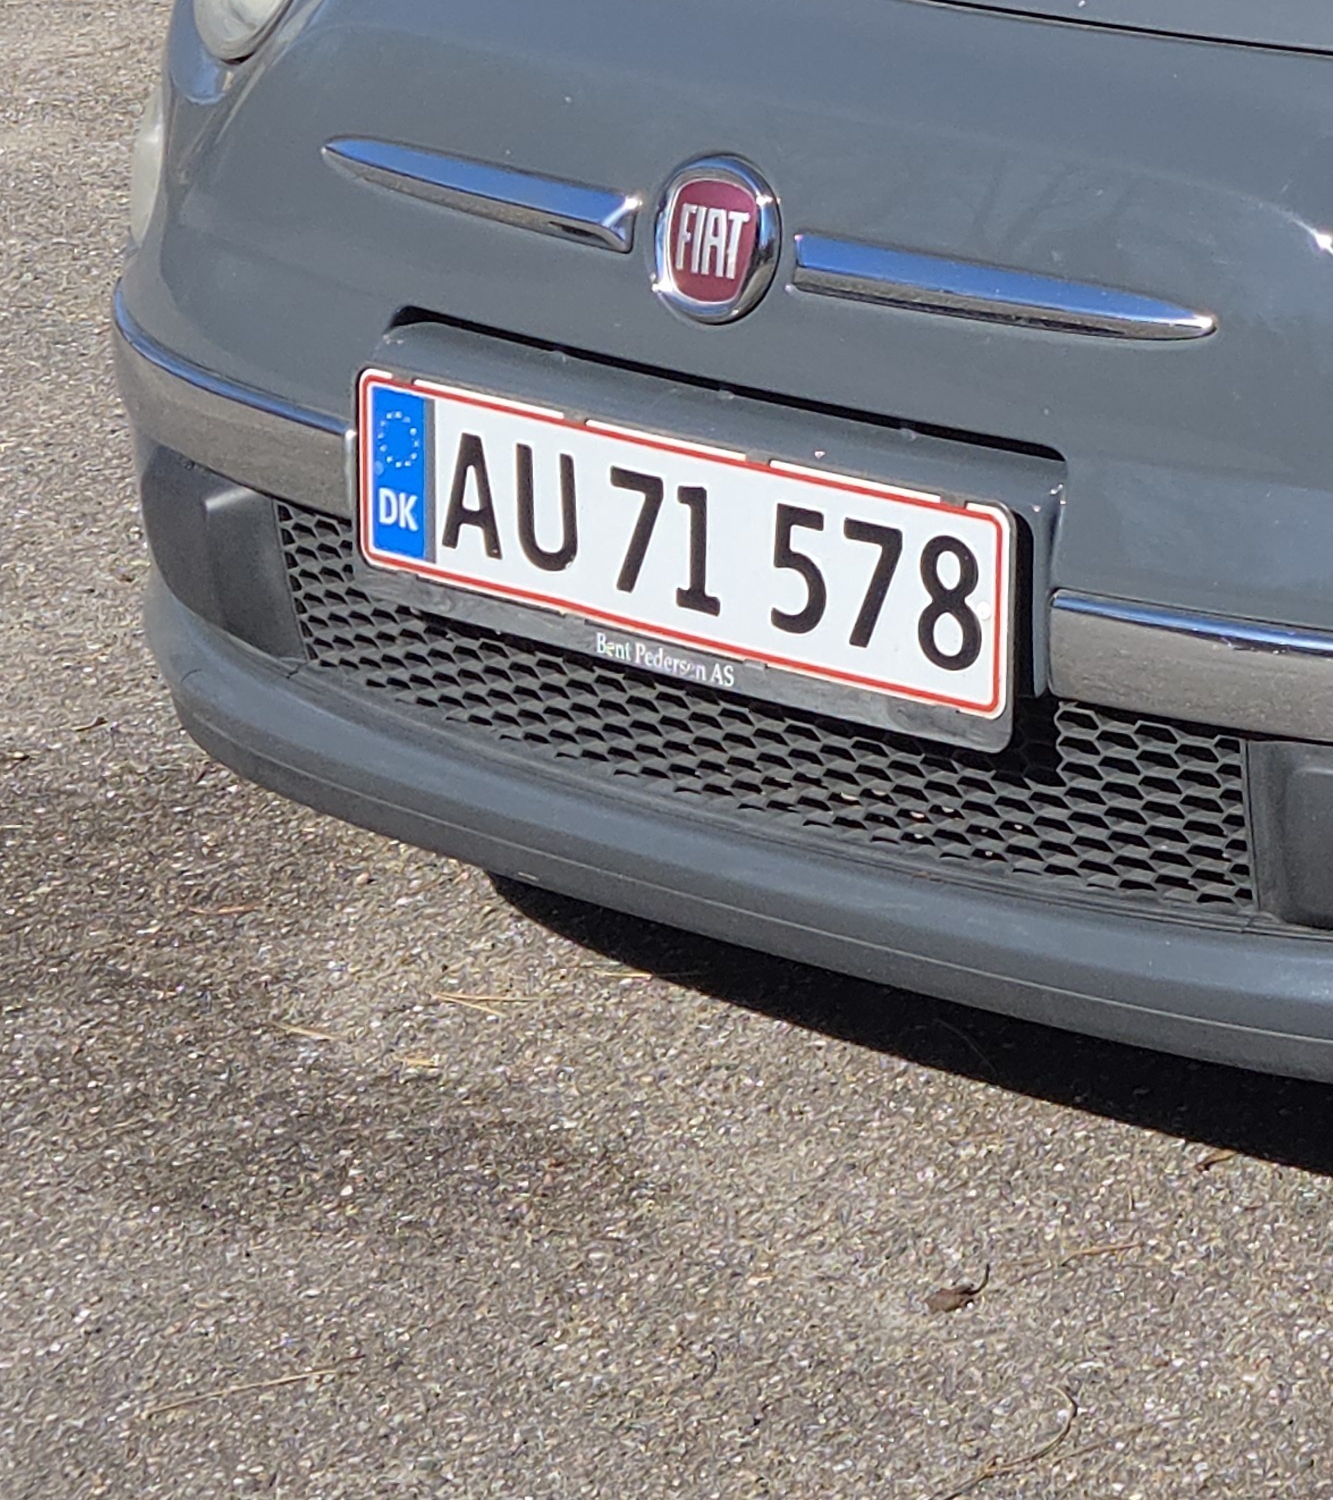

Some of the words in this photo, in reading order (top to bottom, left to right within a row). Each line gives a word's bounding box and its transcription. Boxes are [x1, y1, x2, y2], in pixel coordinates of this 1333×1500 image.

[675, 202, 750, 280] FIAT
[378, 487, 419, 532] DK
[442, 432, 578, 572] AU
[609, 465, 721, 617] 71
[770, 502, 983, 672] 578
[595, 631, 632, 662] Bent
[634, 641, 707, 682] Pedersen
[710, 662, 735, 688] AS
